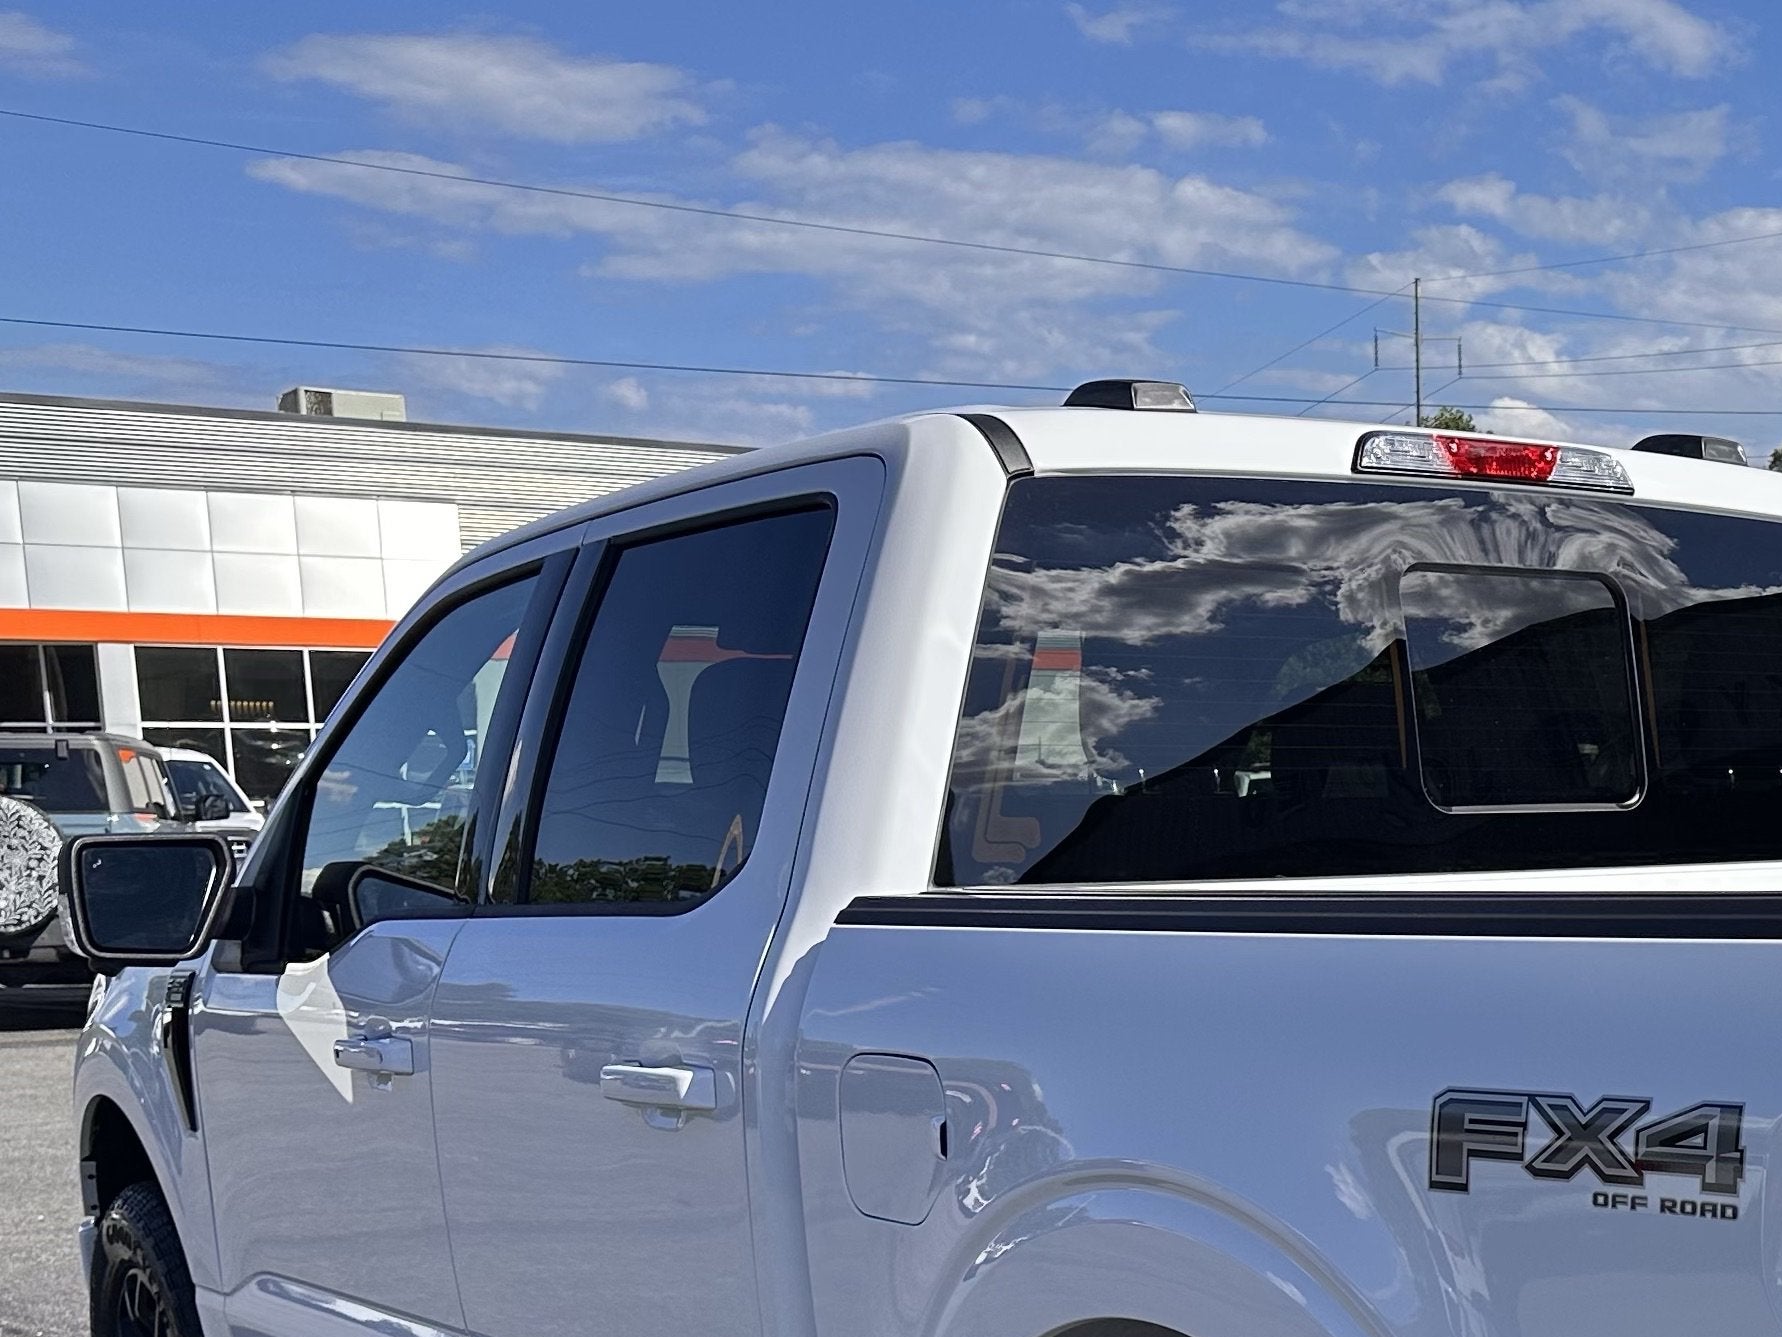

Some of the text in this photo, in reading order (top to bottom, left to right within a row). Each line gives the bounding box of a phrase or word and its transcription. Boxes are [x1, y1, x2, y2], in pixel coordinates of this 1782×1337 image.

[1429, 1086, 1746, 1195] FX4
[1592, 1191, 1739, 1221] OFF ROAD
